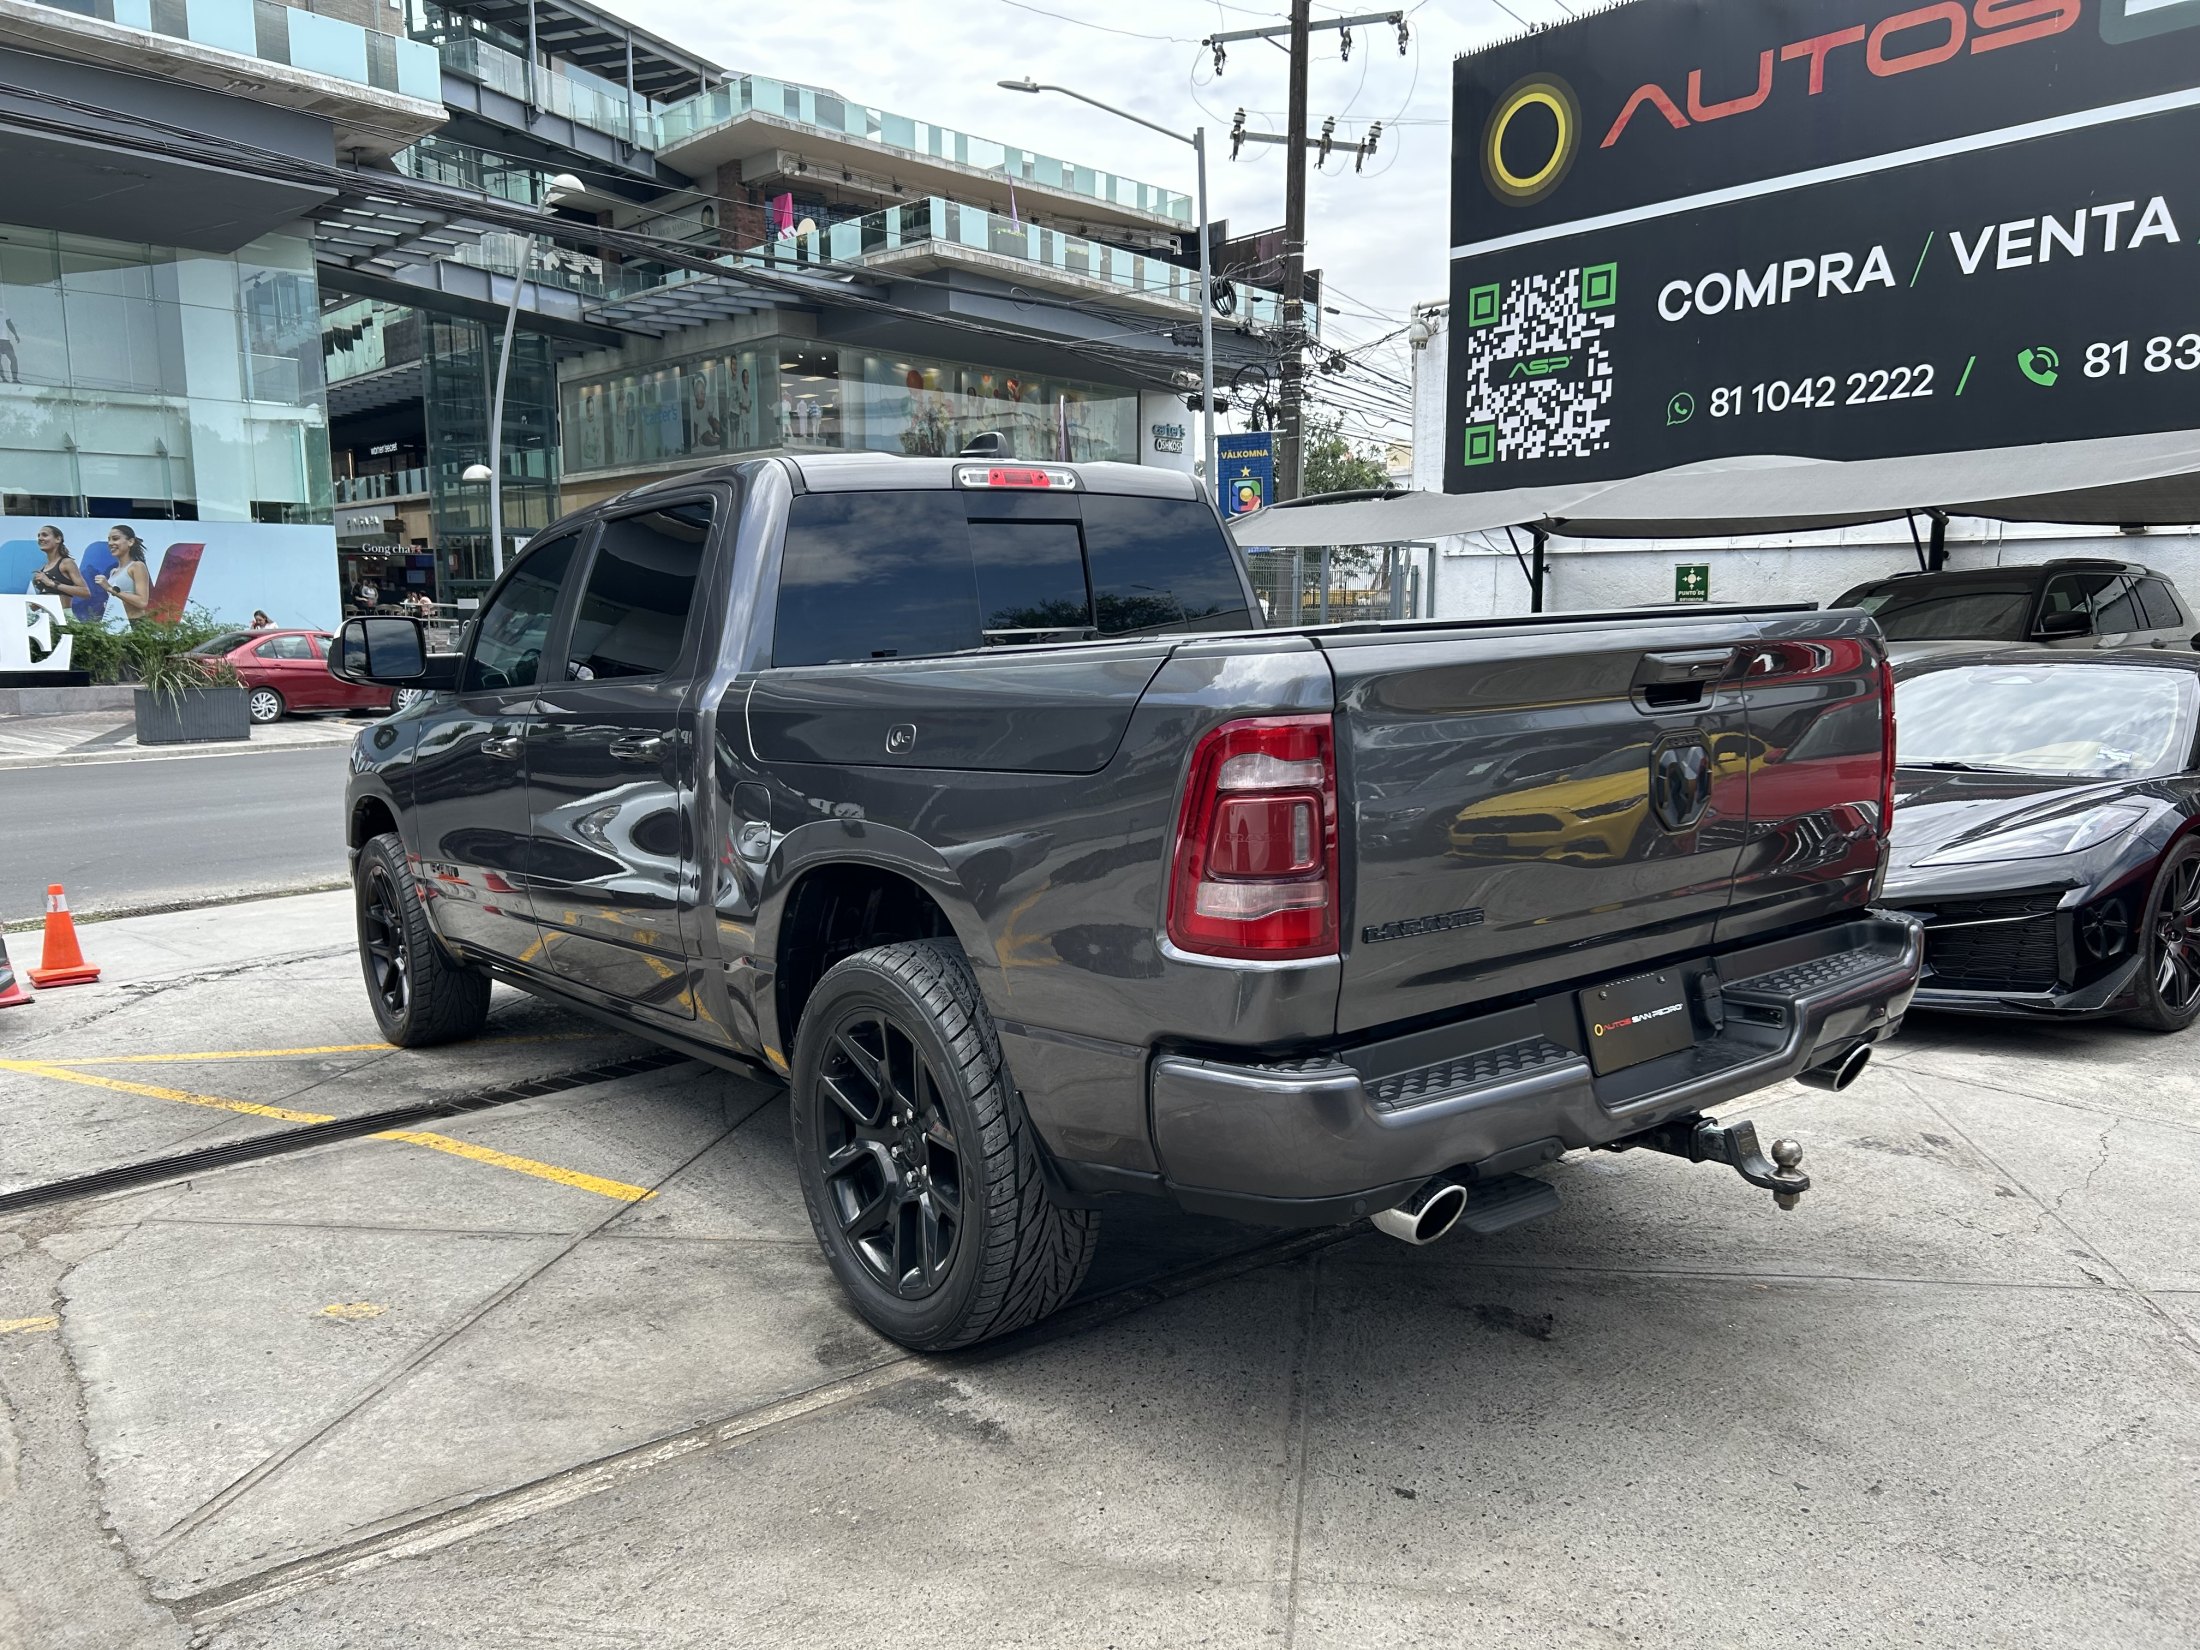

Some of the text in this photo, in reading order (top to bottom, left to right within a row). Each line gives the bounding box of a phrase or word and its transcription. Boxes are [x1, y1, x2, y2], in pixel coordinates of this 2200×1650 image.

[1600, 0, 2081, 148] AUTOS
[1657, 245, 1896, 322] COMPRA
[1949, 196, 2181, 275] VENTA
[1508, 356, 1570, 379] ASP
[1709, 385, 1742, 417] 81
[1751, 375, 1836, 414] 1042
[1846, 364, 1935, 405] 2222
[2083, 340, 2129, 378] 81
[1221, 449, 1269, 460] VÄLKOMNA
[362, 543, 392, 556] Gong
[392, 543, 411, 554] cha
[1603, 1017, 1632, 1031] AUTOS
[1631, 1012, 1652, 1024] SAN
